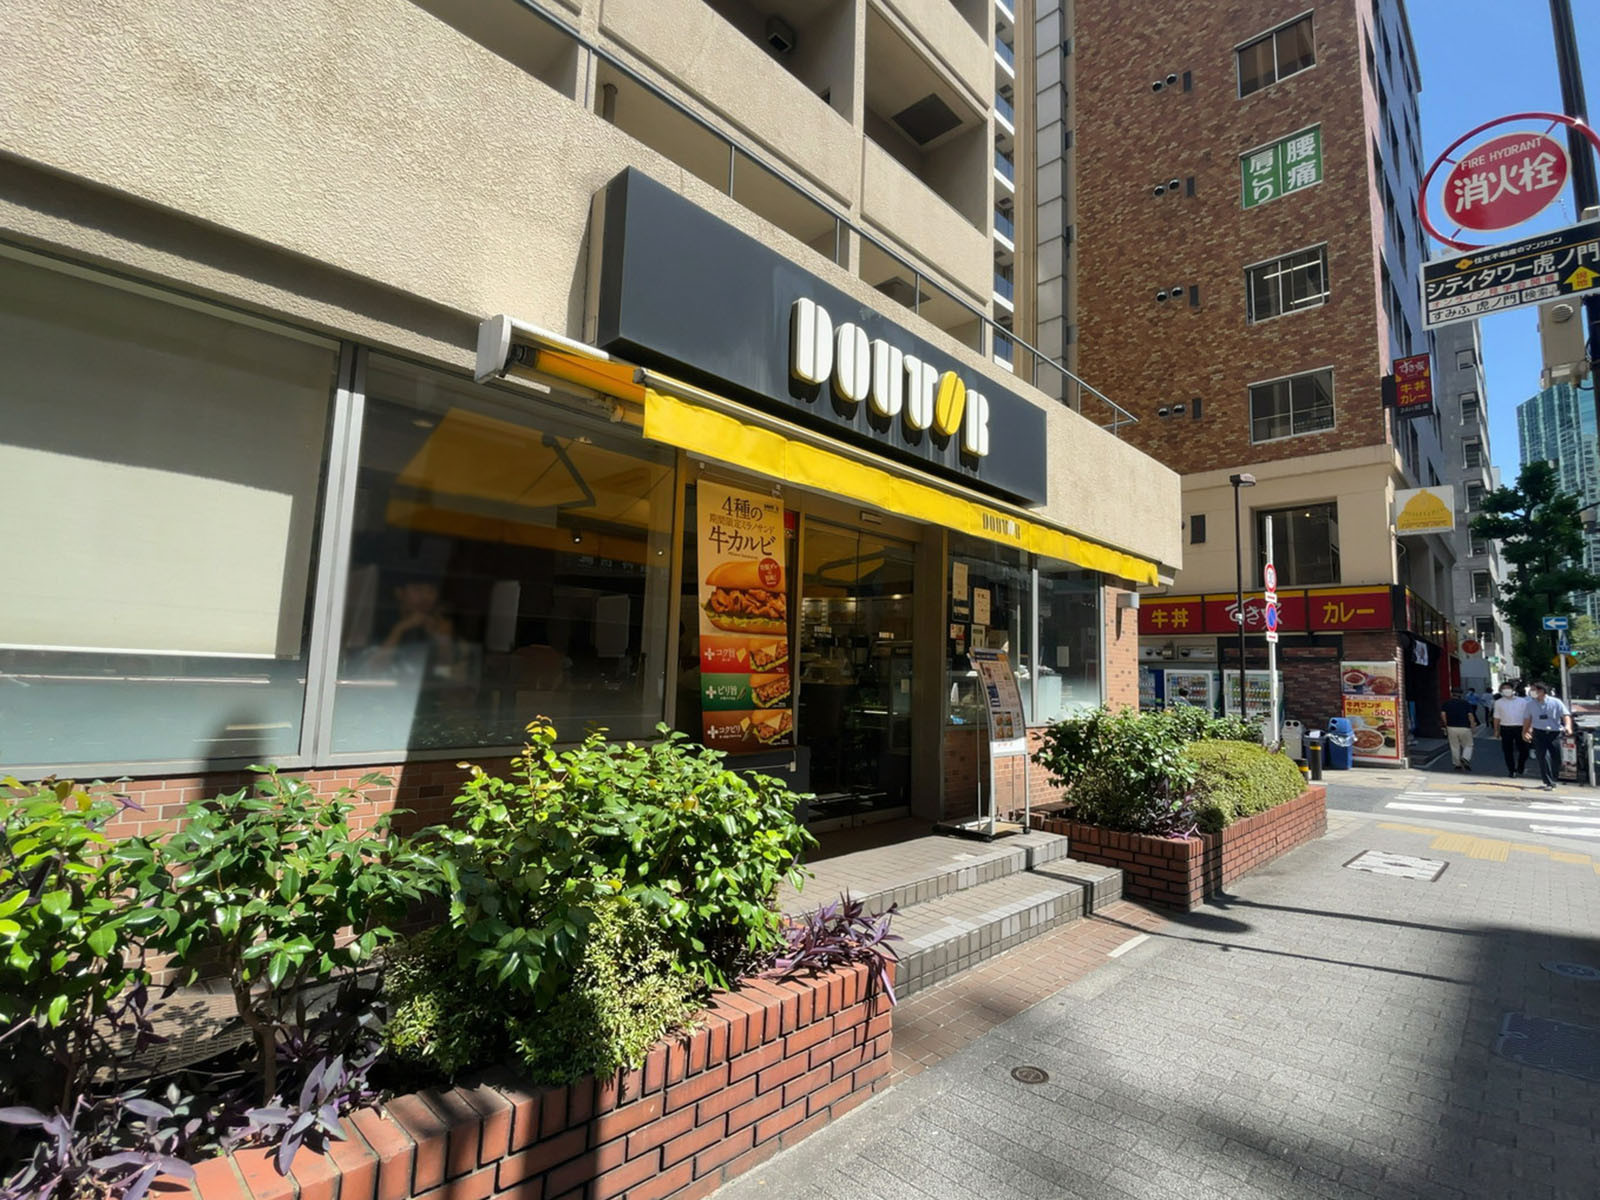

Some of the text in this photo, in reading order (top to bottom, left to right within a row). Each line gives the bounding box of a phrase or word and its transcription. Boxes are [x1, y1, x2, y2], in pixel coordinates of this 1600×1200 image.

[1286, 132, 1316, 190] 腰痛
[1461, 137, 1541, 171] FIRE HYDRANT
[1249, 148, 1274, 204] 肩こり
[1454, 152, 1558, 213] 消火栓
[1427, 242, 1600, 300] シティタワー虎ノ門
[1432, 293, 1517, 320] すみふ 虎ノ門
[789, 297, 989, 457] DOUTOR
[1400, 393, 1428, 404] カレー
[721, 496, 763, 521] 4種の
[709, 525, 776, 555] 牛カルビ
[1151, 608, 1189, 628] 牛丼
[1322, 601, 1375, 623] カレー
